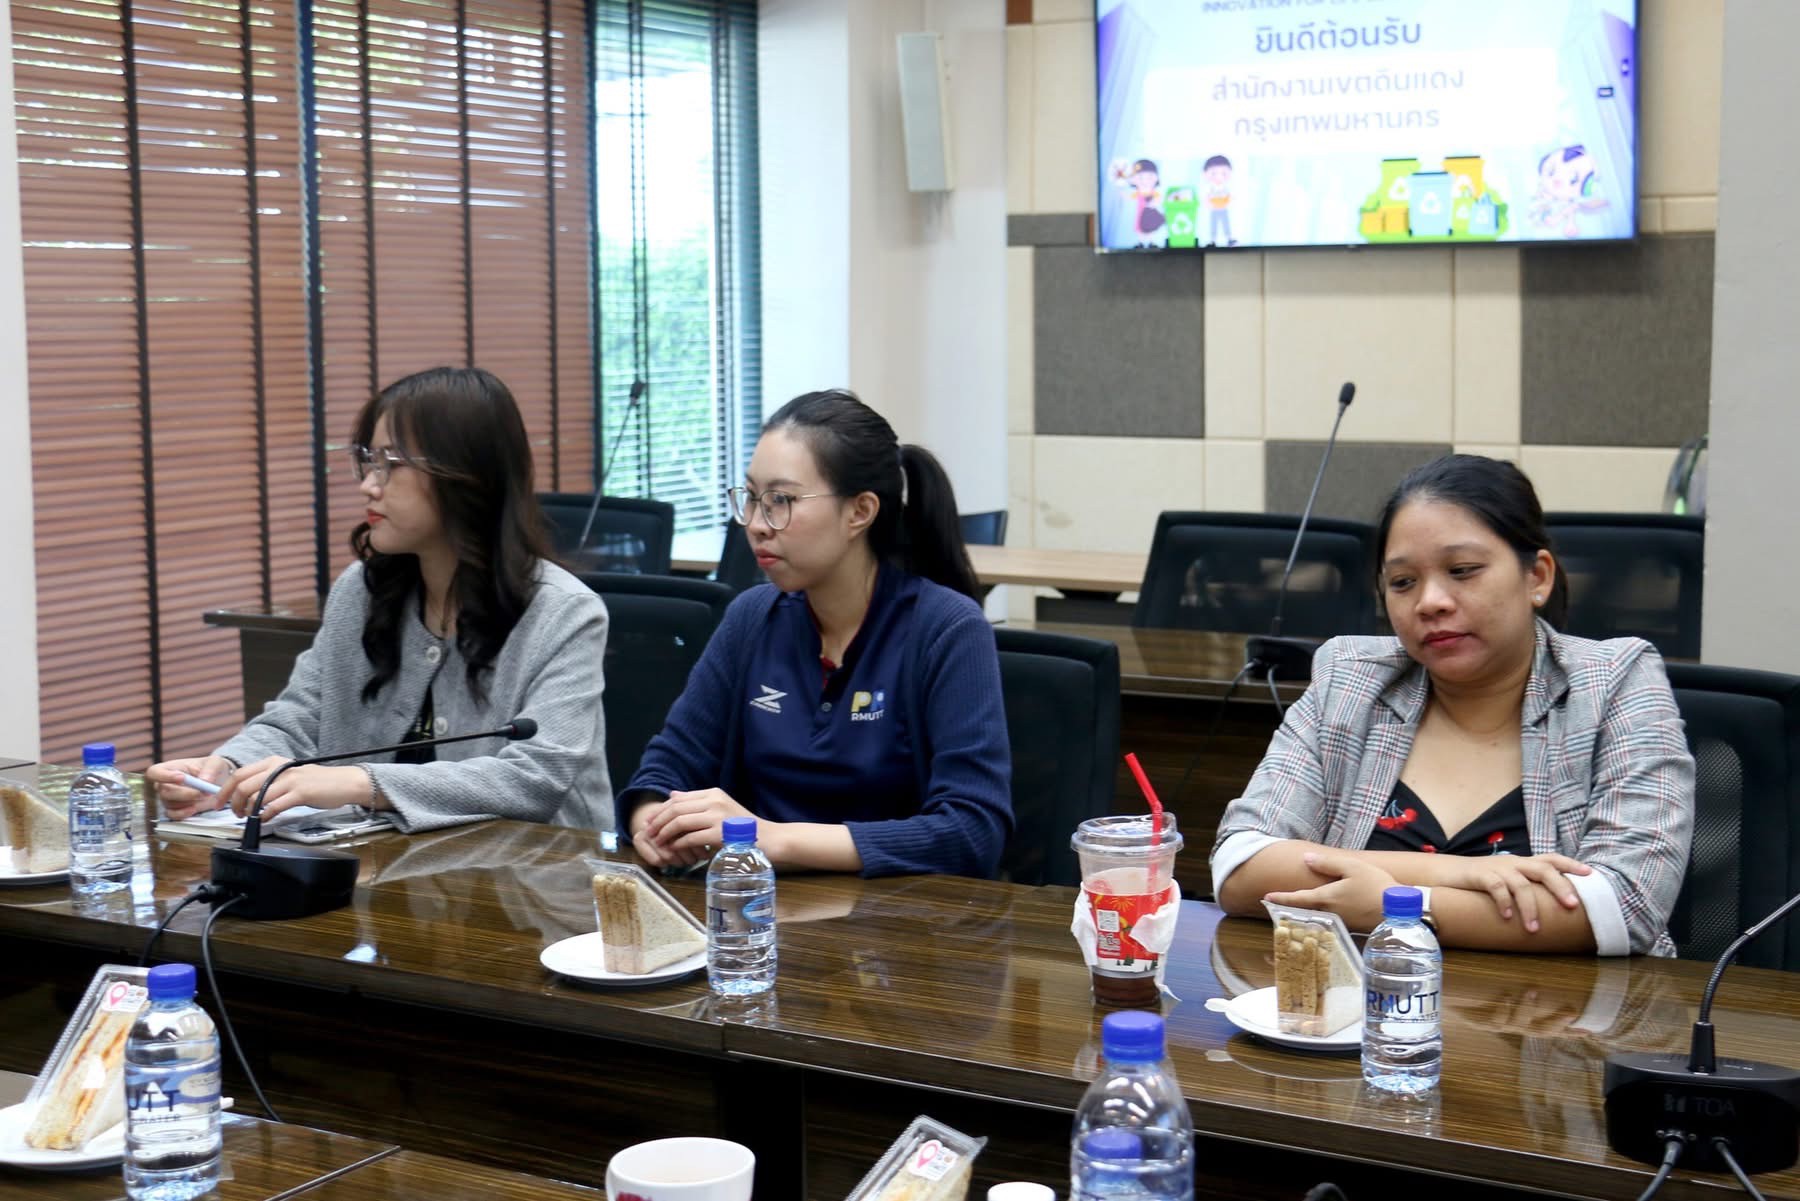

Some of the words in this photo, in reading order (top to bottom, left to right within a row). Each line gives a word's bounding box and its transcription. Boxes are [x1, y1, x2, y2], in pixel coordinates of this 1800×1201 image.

[1254, 16, 1422, 53] ยินดีต้อนรับ
[1234, 108, 1441, 142] กรุงเทพมหานคร
[1367, 990, 1439, 1015] RMUTT
